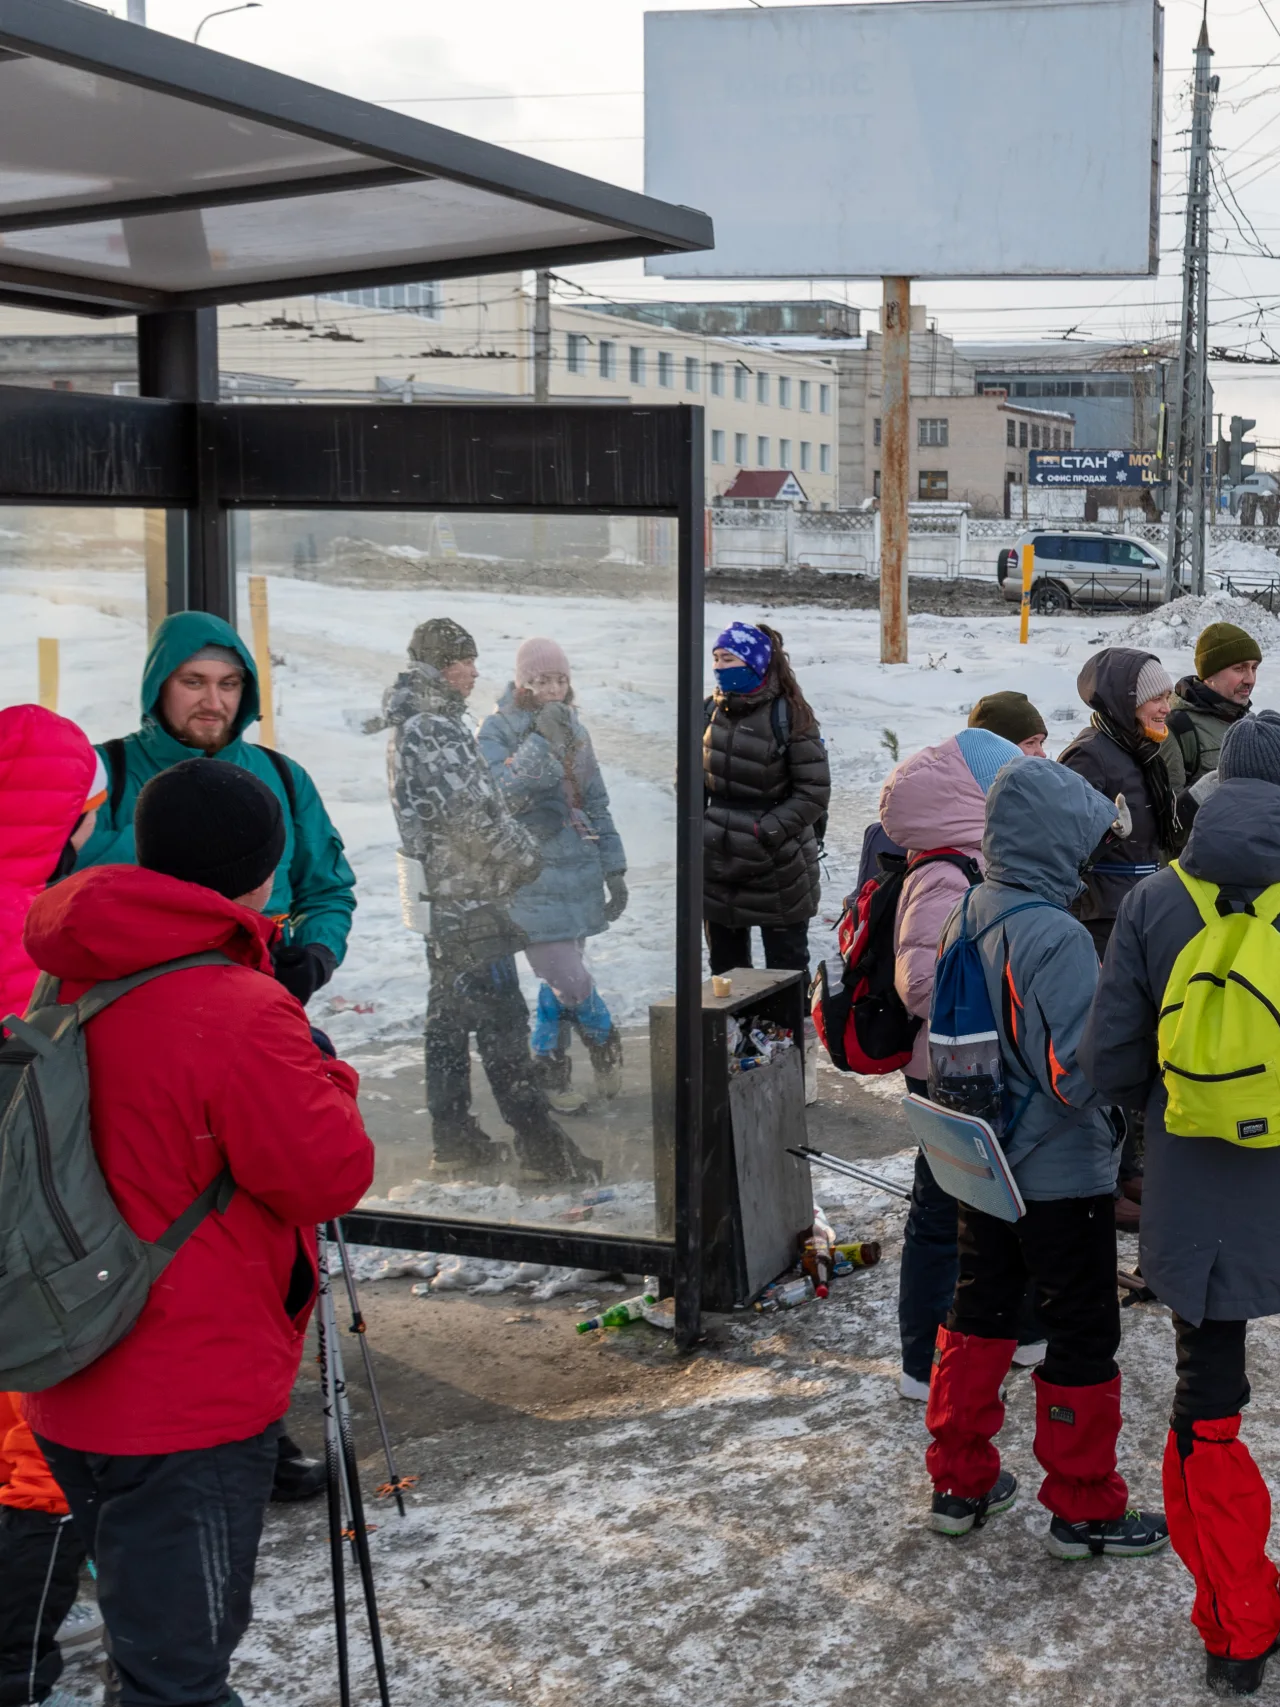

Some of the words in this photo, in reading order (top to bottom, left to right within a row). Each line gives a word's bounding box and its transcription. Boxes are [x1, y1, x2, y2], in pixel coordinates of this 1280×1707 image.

[1061, 456, 1108, 468] СТАН
[1047, 474, 1072, 482] ОФИС
[1072, 474, 1107, 483] ПРОДАЖ
